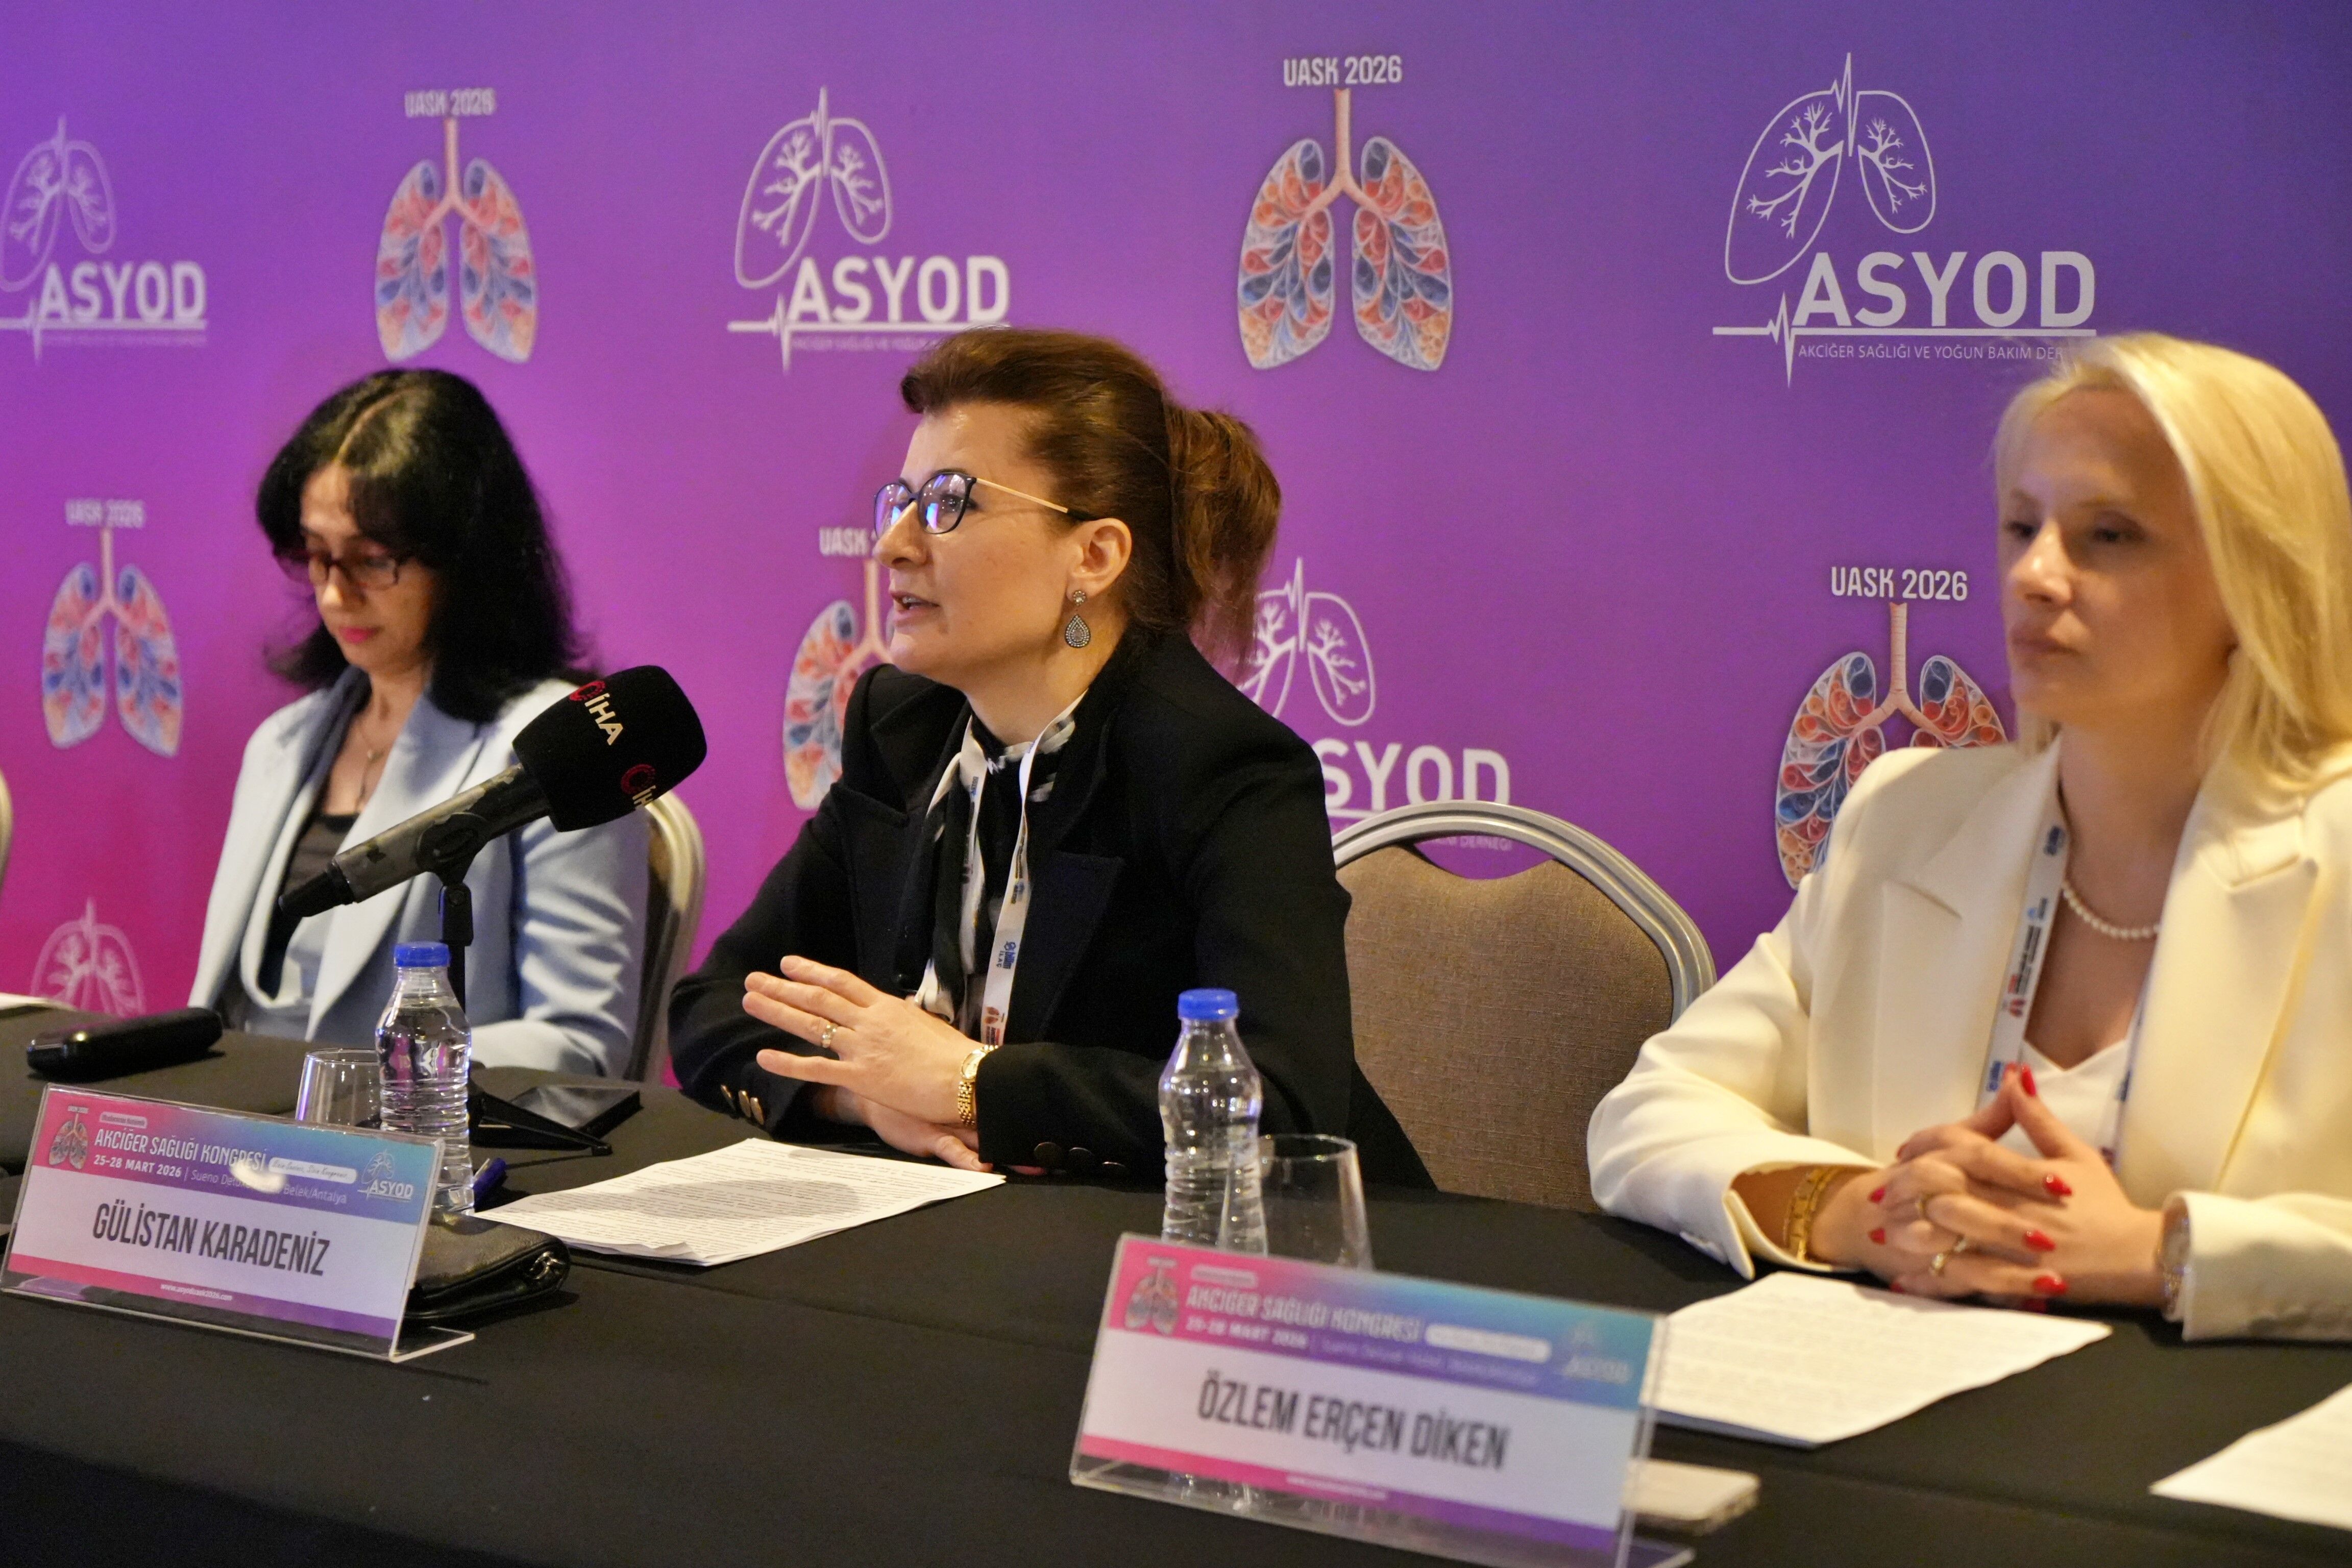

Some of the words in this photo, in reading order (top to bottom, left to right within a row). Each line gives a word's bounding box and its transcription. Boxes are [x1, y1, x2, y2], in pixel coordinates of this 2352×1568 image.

[1283, 57, 1339, 87] UASK
[1344, 55, 1403, 84] 2026
[38, 260, 207, 323] ASYOD
[787, 255, 1011, 324] ASYOD
[1791, 250, 2095, 327] ASYOD
[1798, 343, 1854, 358] AKCİĞER
[1858, 344, 1910, 358] SAĞLIĞI
[1914, 346, 1930, 358] VE
[1934, 344, 1983, 359] YOĞUN
[1988, 346, 2032, 359] BAKIM
[1830, 566, 1894, 598] UASK
[1901, 569, 1968, 601] 2026
[94, 1128, 149, 1154] AKCİĞER
[150, 1135, 200, 1160] SAĞLIĞI
[93, 1154, 122, 1169] 25-28
[125, 1159, 156, 1174] MART
[157, 1164, 182, 1178] 2026
[190, 1169, 218, 1184] Sueno
[369, 1179, 414, 1198] ASYOD
[92, 1198, 198, 1254] GÜLİSTAN
[199, 1220, 331, 1277] KARADENİZ
[1197, 1367, 1298, 1434] ÖZLEM
[1303, 1394, 1406, 1454] ERÇEN
[1408, 1407, 1512, 1470] DİKEN
